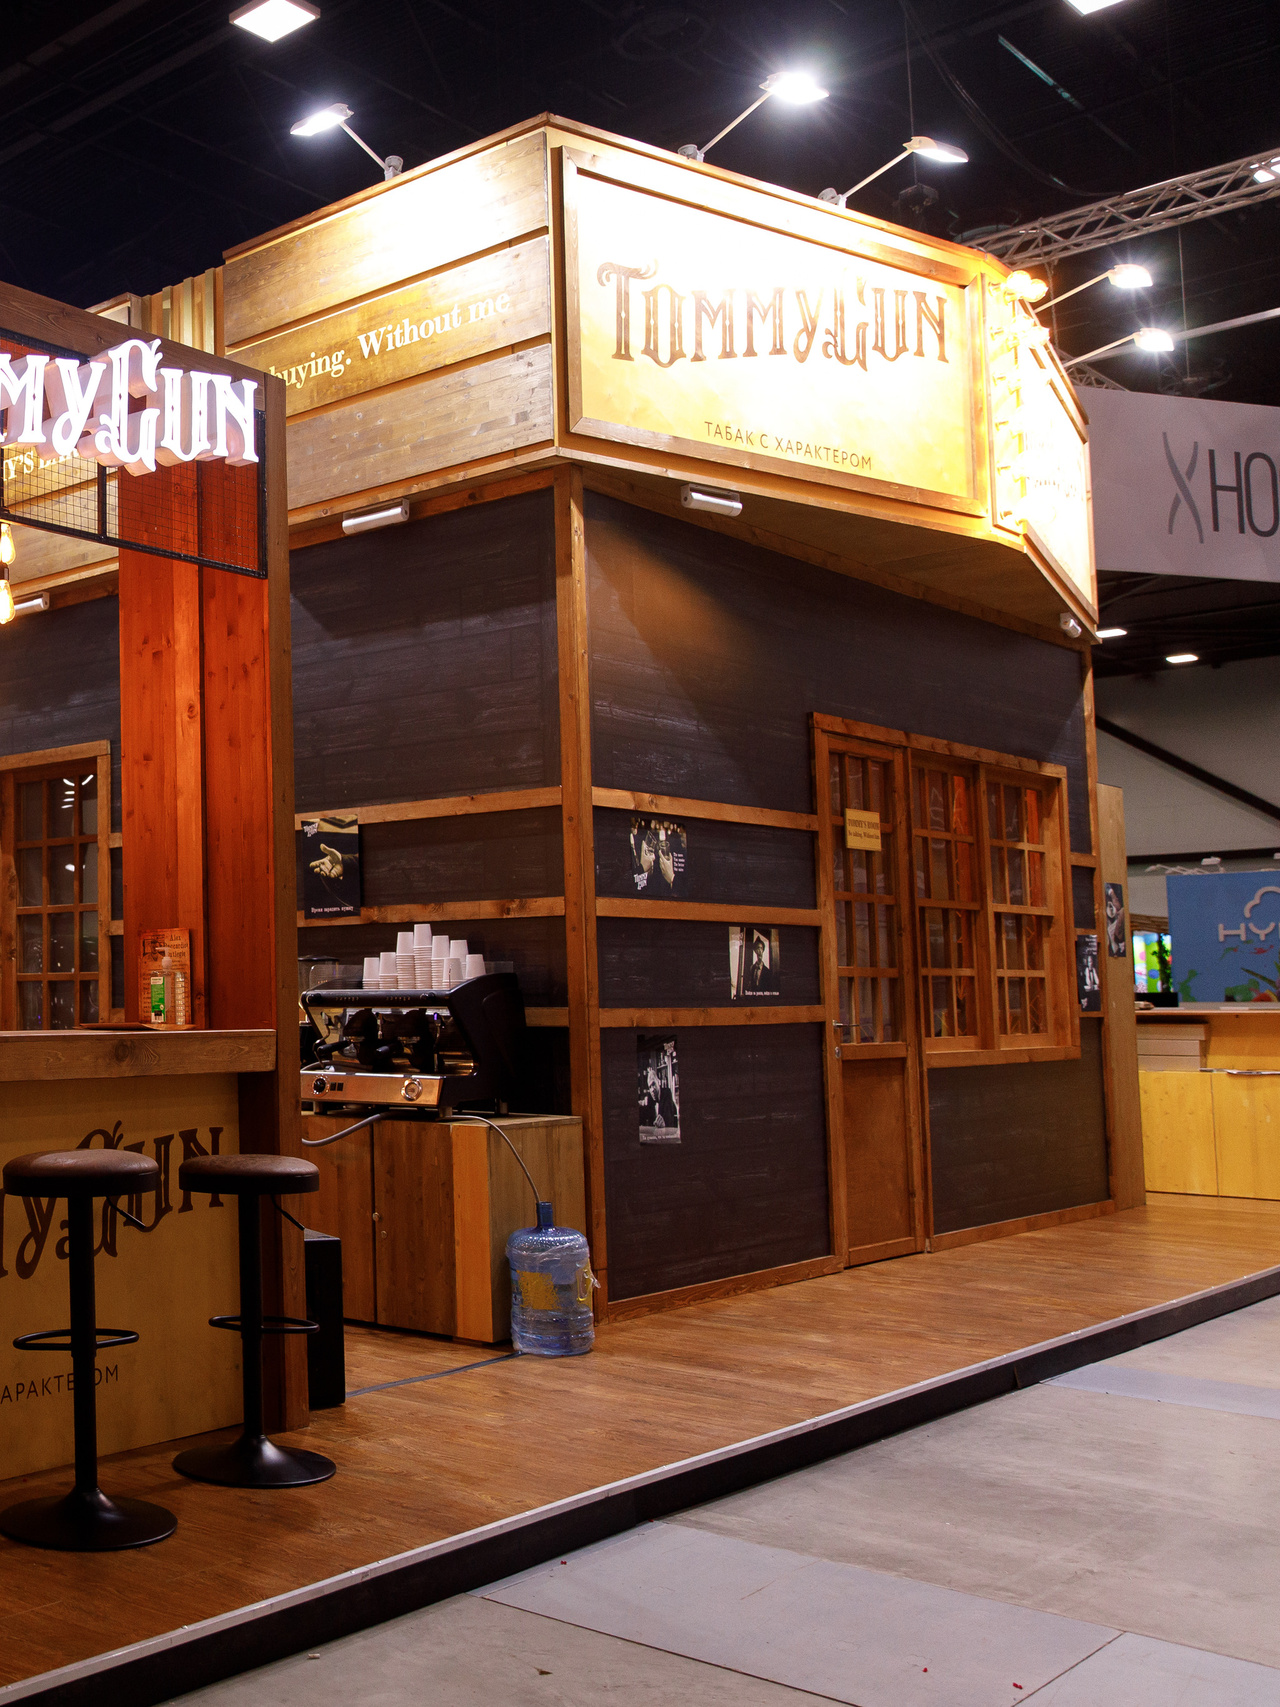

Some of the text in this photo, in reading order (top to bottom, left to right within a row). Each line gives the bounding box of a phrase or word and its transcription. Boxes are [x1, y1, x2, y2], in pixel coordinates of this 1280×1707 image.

[357, 303, 462, 359] Without
[467, 292, 511, 325] me
[704, 421, 754, 446] ТАБАК
[775, 438, 872, 471] ХАРАКТЕРОМ
[1218, 922, 1280, 942] HY
